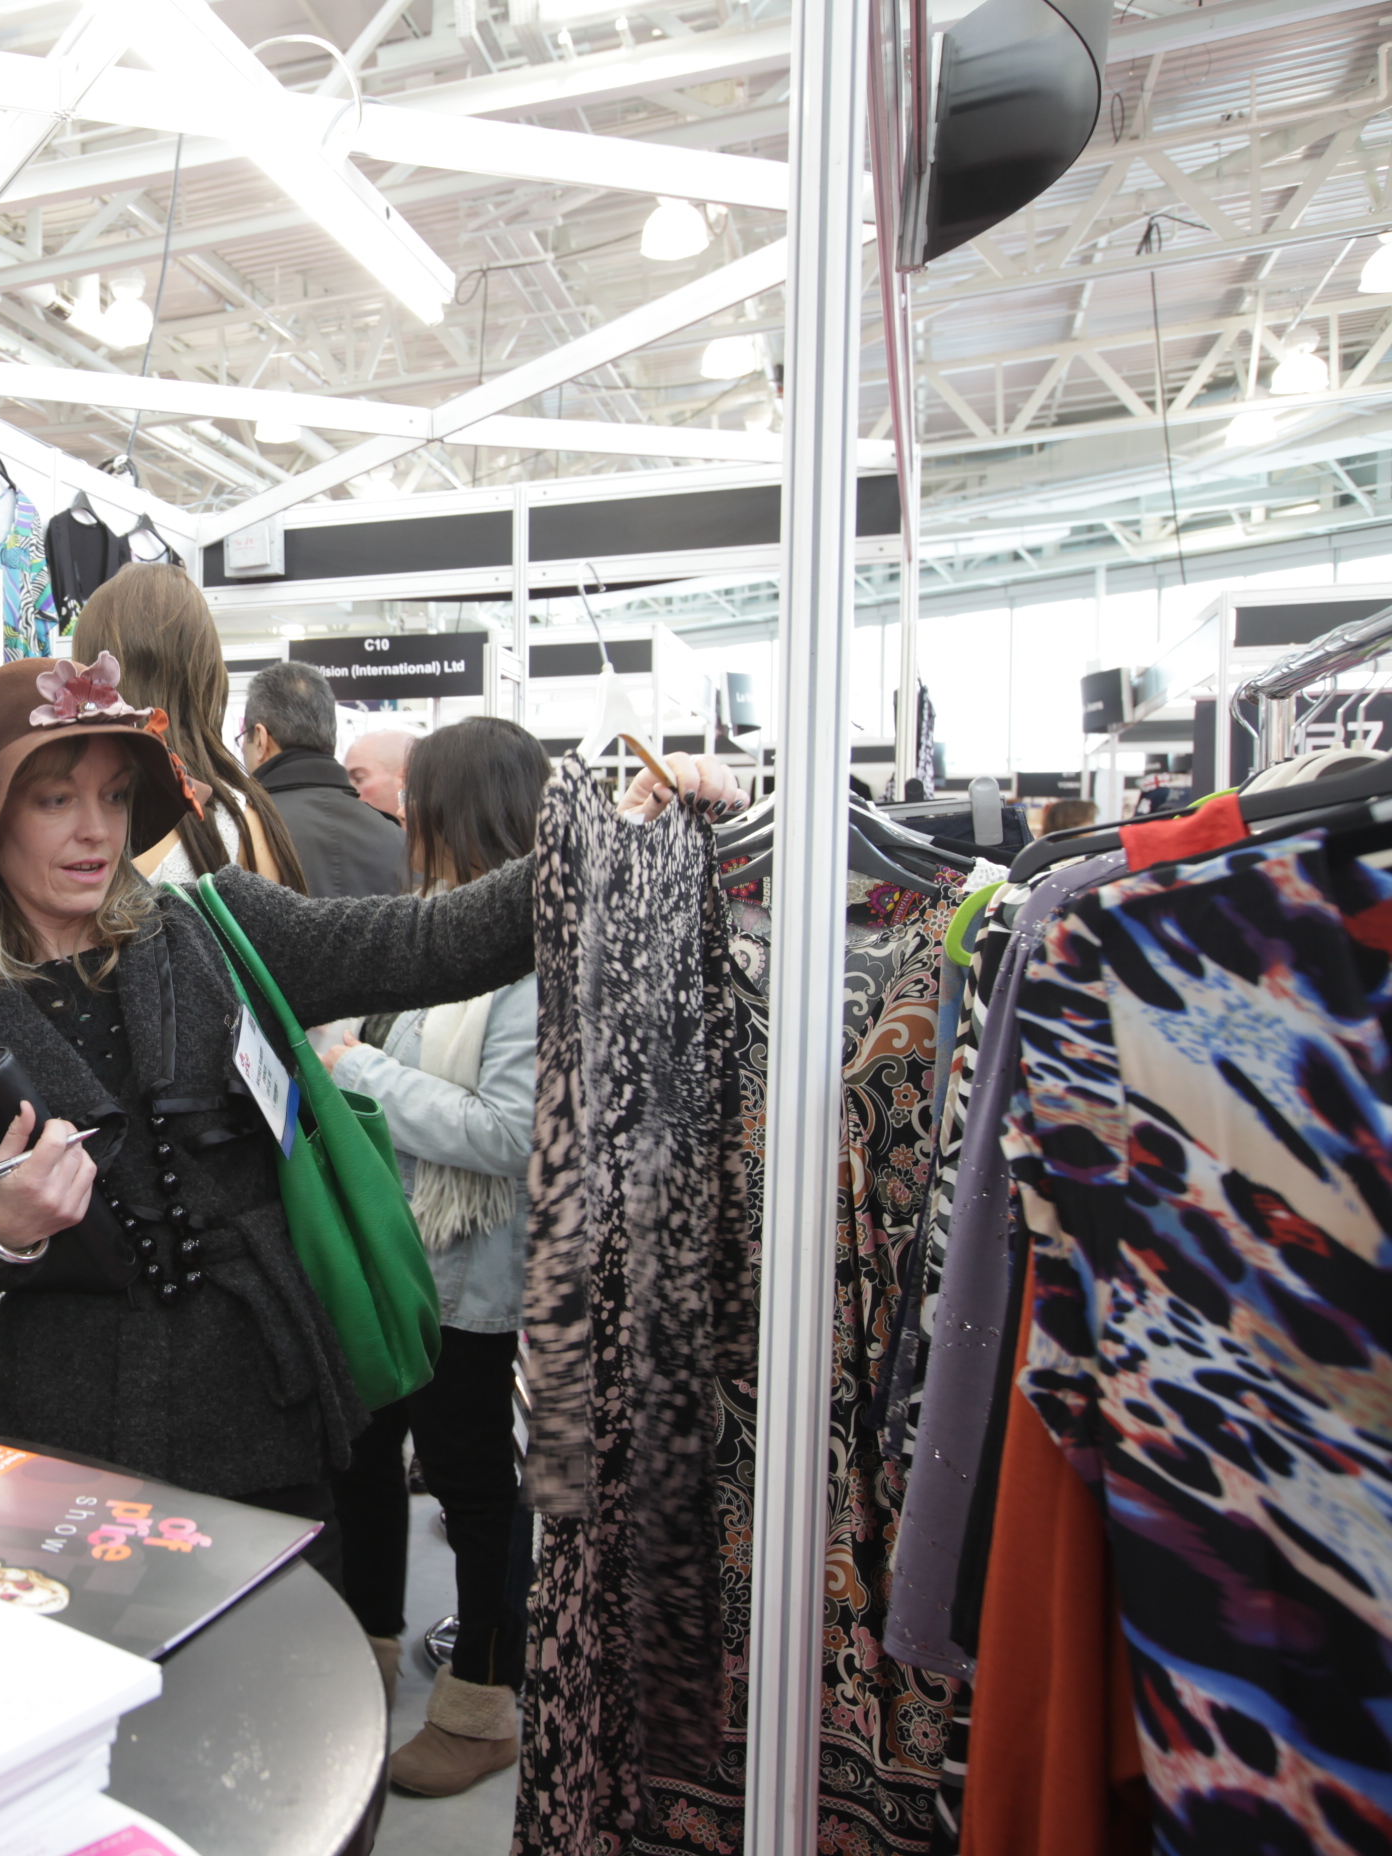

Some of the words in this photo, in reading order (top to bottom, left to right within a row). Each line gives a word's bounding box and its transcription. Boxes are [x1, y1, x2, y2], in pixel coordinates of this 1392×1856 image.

[364, 638, 390, 651] C10
[351, 661, 441, 679] (International)
[444, 660, 465, 673] Ltd
[41, 1495, 97, 1554] show
